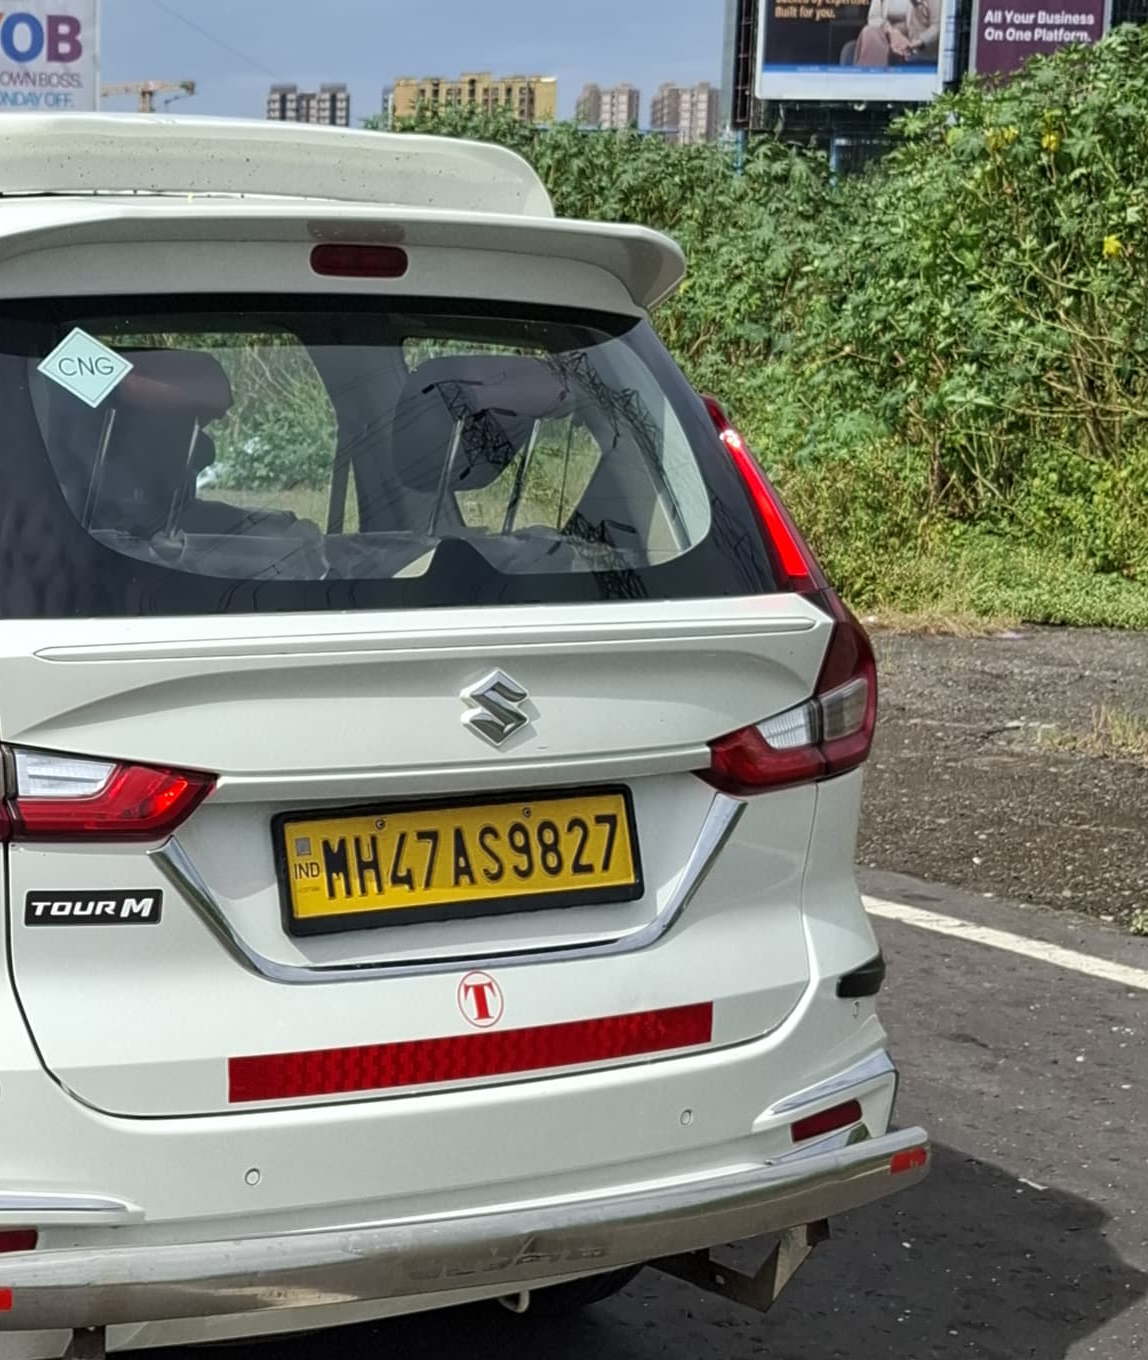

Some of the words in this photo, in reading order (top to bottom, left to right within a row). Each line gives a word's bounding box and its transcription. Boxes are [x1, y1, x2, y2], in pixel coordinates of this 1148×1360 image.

[775, 6, 797, 18] Built
[800, 6, 813, 18] for
[815, 10, 836, 21] you.
[984, 9, 1002, 24] All
[1004, 10, 1035, 24] Your
[1037, 10, 1095, 25] Business
[984, 27, 1003, 41] On
[1005, 27, 1031, 41] One
[0, 71, 37, 87] OWN
[58, 356, 114, 377] CNG
[321, 813, 619, 900] MH47AS9827
[294, 862, 321, 880] IND
[31, 901, 117, 916] TOUR
[119, 897, 154, 918] M
[464, 981, 497, 1021] T
